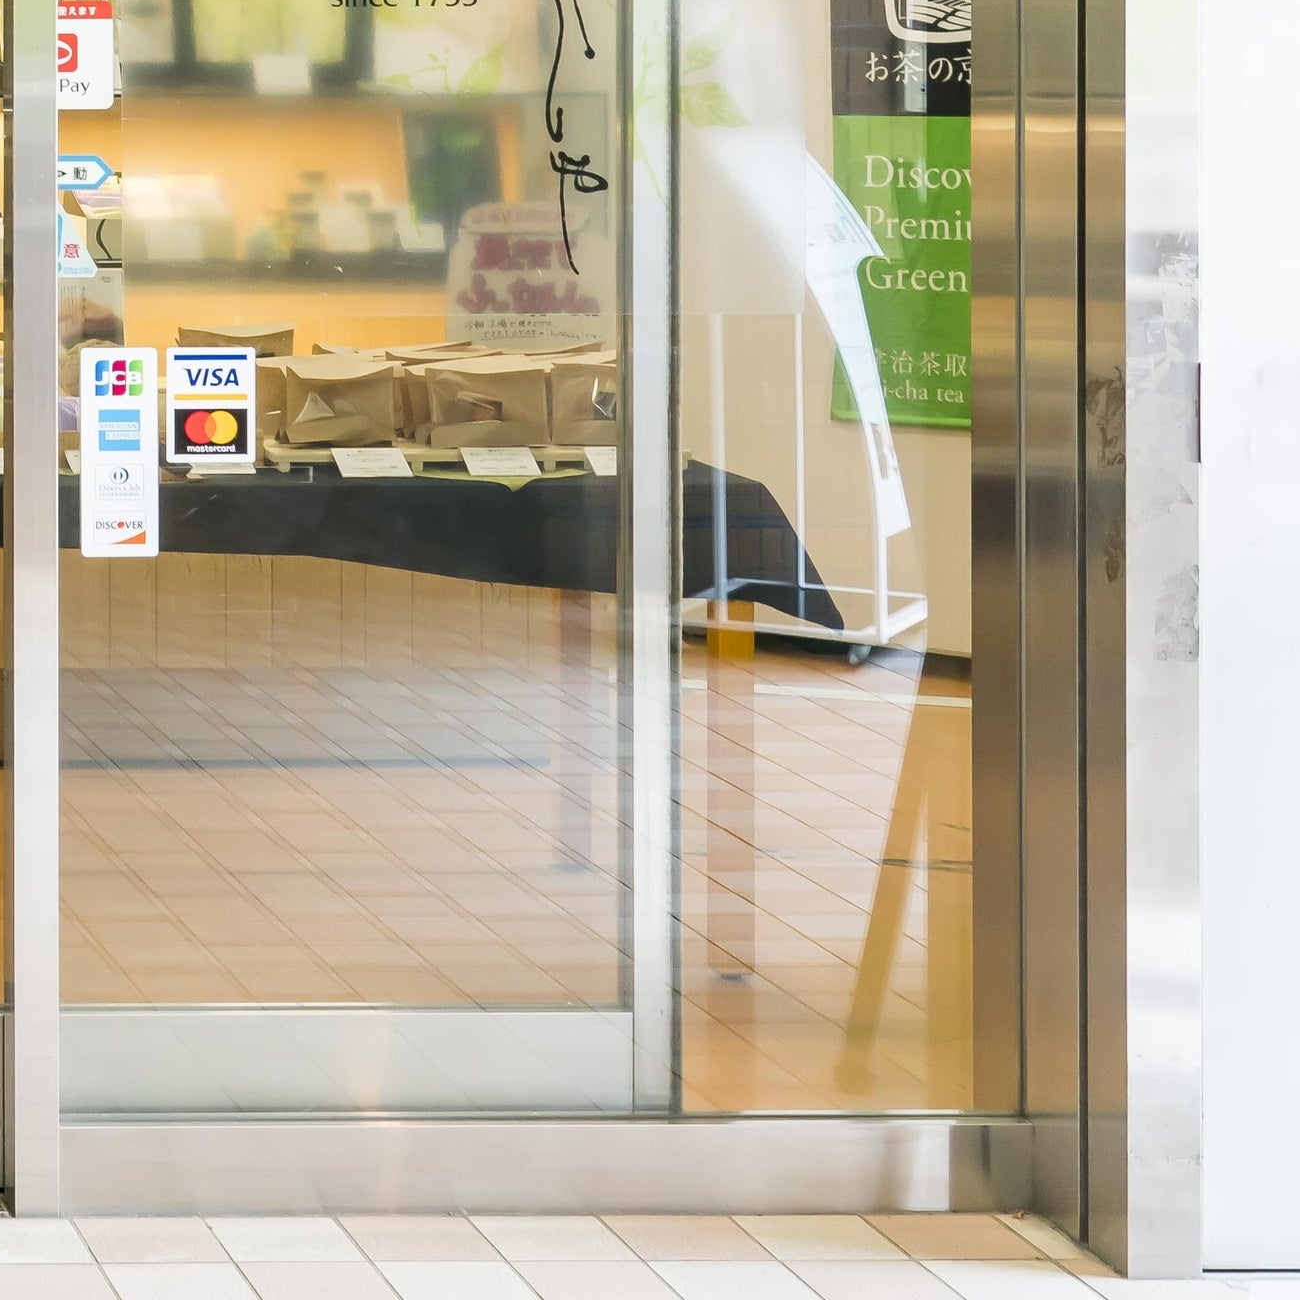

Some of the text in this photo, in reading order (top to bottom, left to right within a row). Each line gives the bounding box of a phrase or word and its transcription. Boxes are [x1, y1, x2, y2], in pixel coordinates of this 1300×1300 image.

[59, 78, 91, 96] Pay
[864, 204, 972, 241] Premi
[63, 243, 81, 259] 意
[864, 255, 969, 293] Green
[95, 368, 144, 388] JCB
[181, 367, 240, 387] VISA
[936, 387, 965, 404] tea
[186, 444, 237, 453] mastercard
[95, 521, 143, 530] DISCOVER
